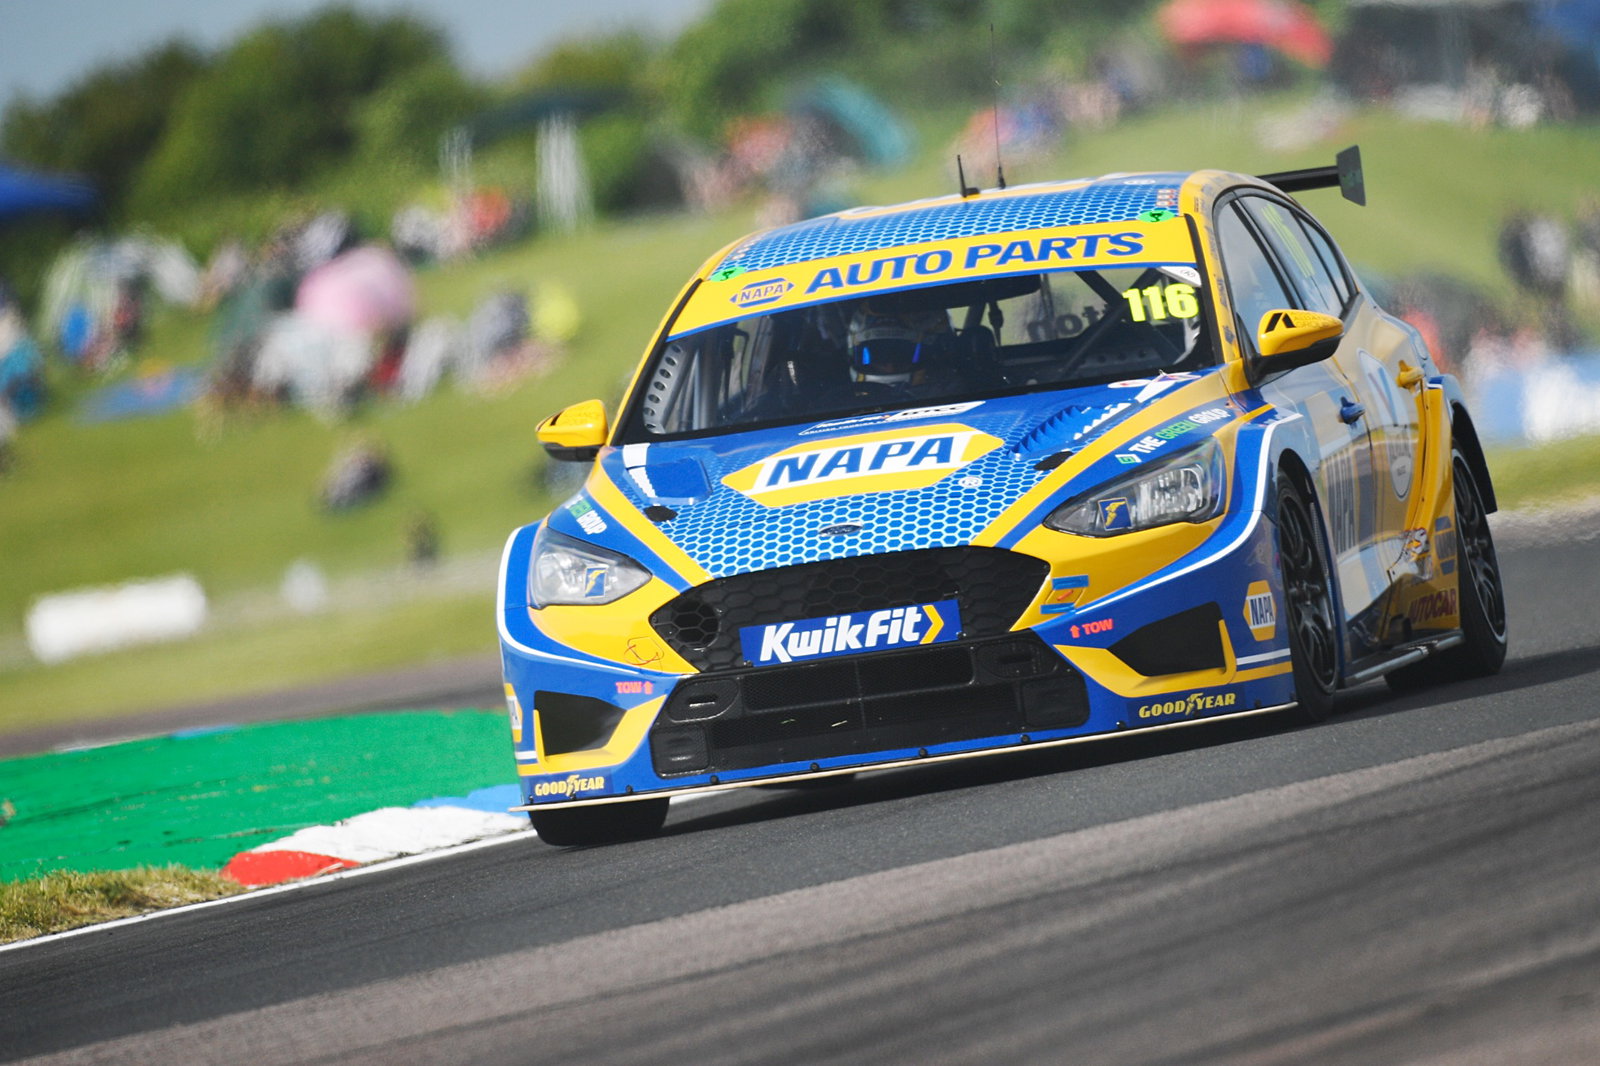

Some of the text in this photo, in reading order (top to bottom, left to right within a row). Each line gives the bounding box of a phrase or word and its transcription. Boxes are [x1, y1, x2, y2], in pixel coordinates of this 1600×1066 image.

[740, 231, 1144, 302] NAPA AUTO PARTS
[1122, 283, 1199, 323] 116
[1128, 408, 1231, 454] THE GREEN GROUP
[768, 436, 954, 486] NAPA
[1250, 595, 1275, 626] NAPA
[1082, 618, 1114, 635] TOW
[616, 681, 642, 694] TOW
[1139, 692, 1236, 719] GOODYEAR
[535, 774, 605, 797] GOODYEAR
